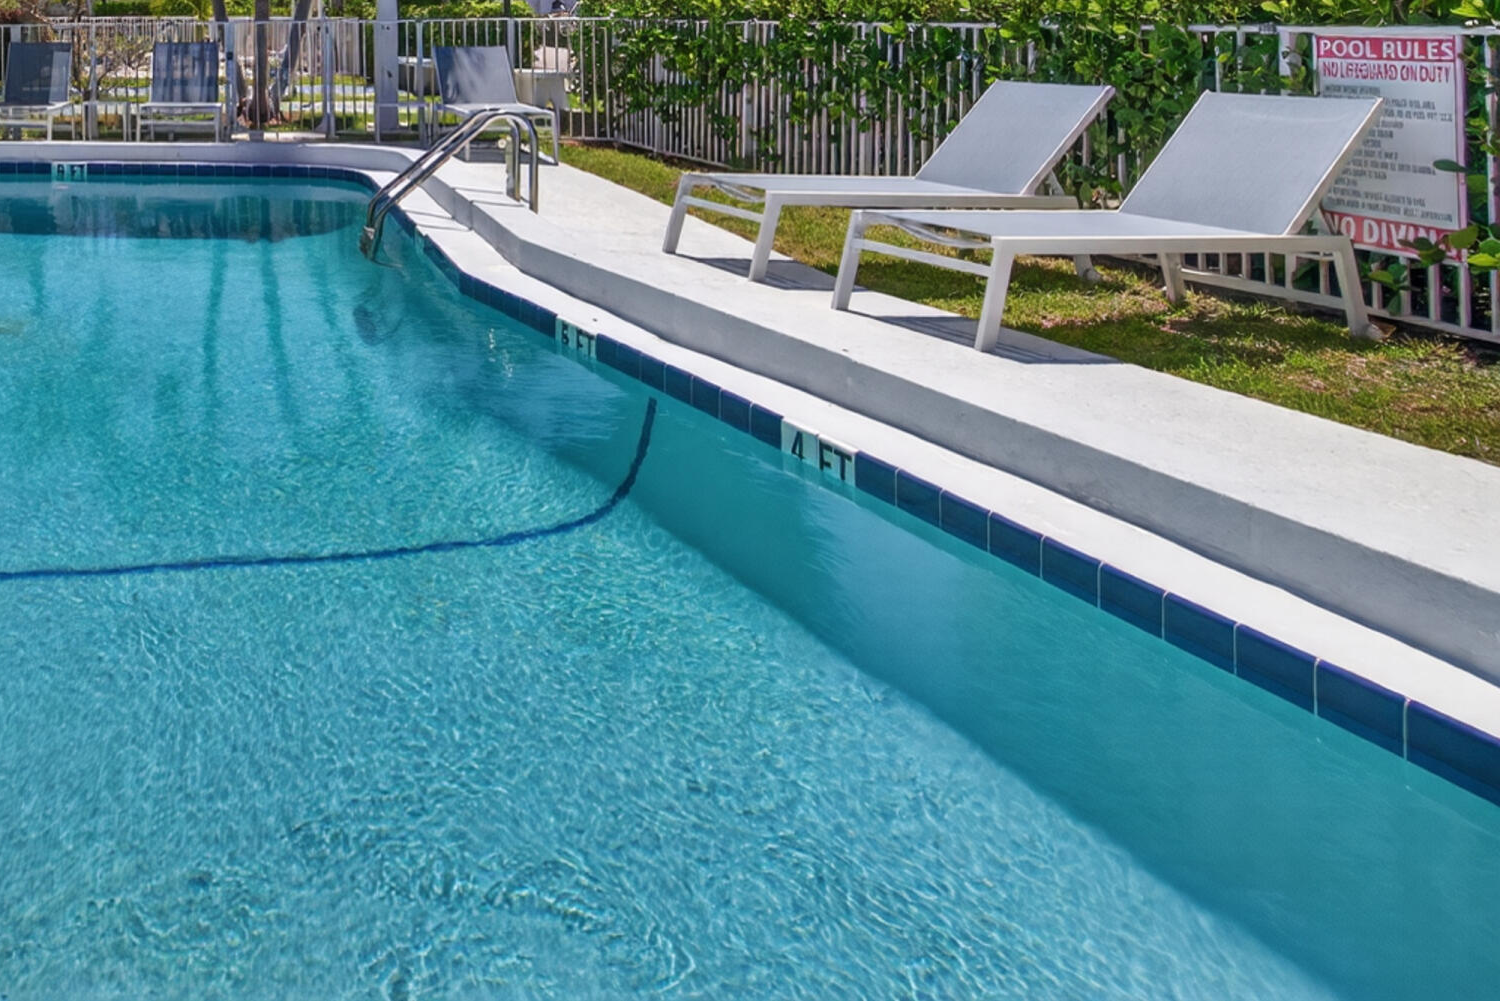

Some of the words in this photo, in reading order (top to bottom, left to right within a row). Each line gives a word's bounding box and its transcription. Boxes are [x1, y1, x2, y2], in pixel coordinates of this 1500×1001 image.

[1320, 39, 1377, 58] POOL
[1382, 40, 1454, 60] RULES
[1323, 61, 1338, 78] NO
[1400, 64, 1417, 82] ON
[1419, 65, 1451, 83] DUTY
[576, 327, 596, 355] FT
[791, 430, 804, 461] 4
[819, 440, 853, 482] FT
